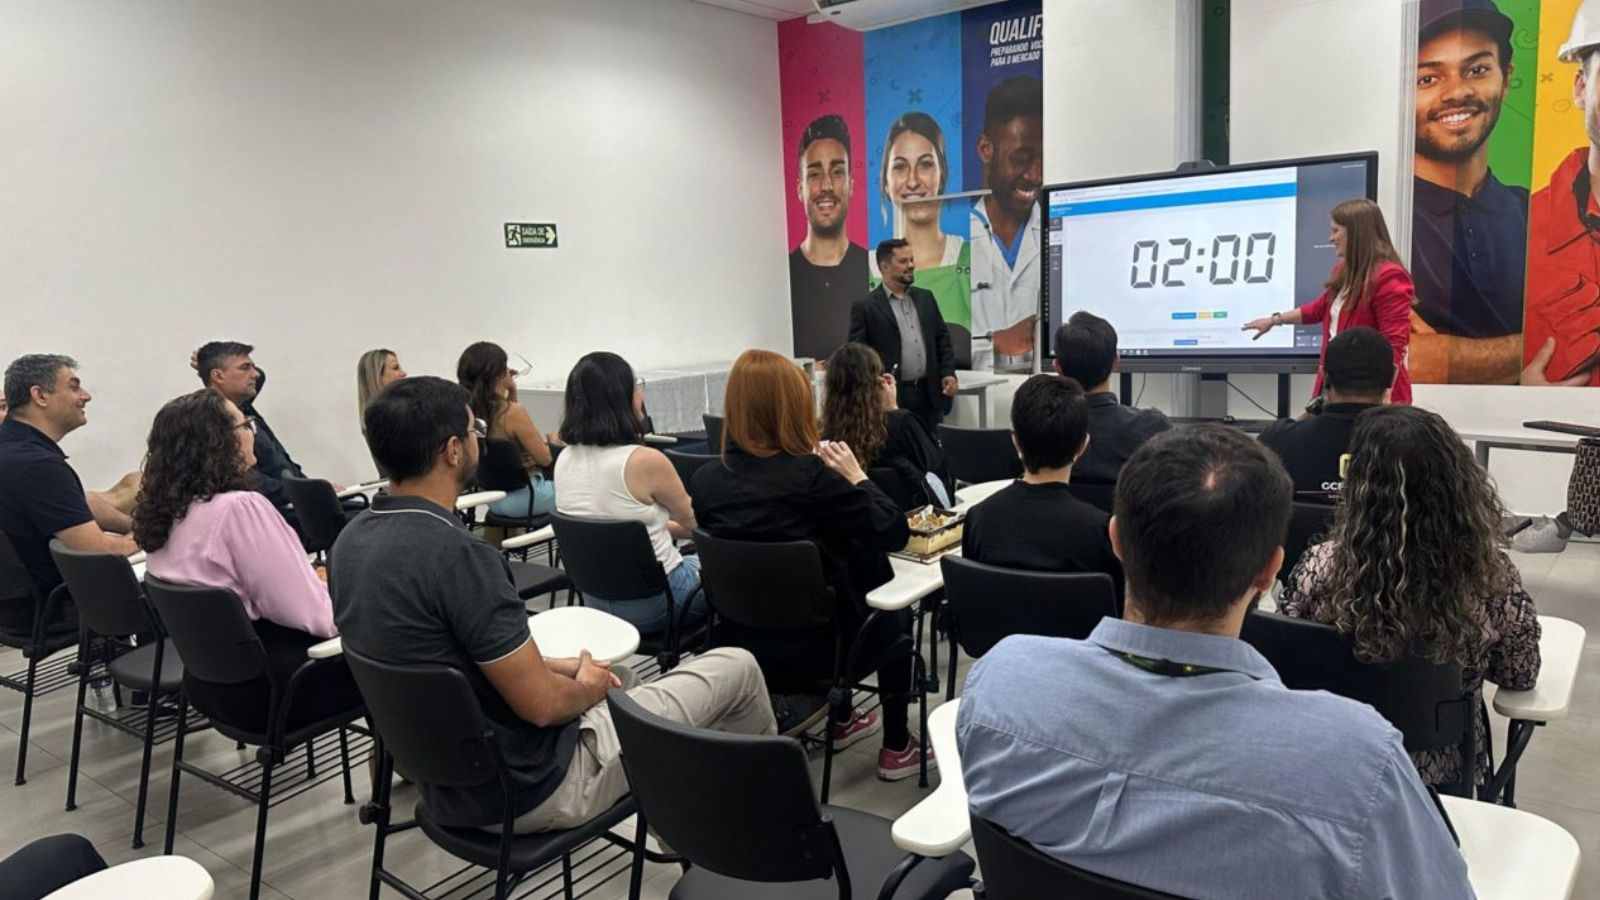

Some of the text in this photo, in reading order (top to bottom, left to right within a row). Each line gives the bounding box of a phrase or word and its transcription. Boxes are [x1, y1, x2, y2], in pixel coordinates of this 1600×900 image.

[989, 14, 1044, 45] QUALIF
[990, 56, 1006, 67] PARA
[1011, 51, 1041, 64] MERCADO
[1130, 231, 1277, 288] 02:00
